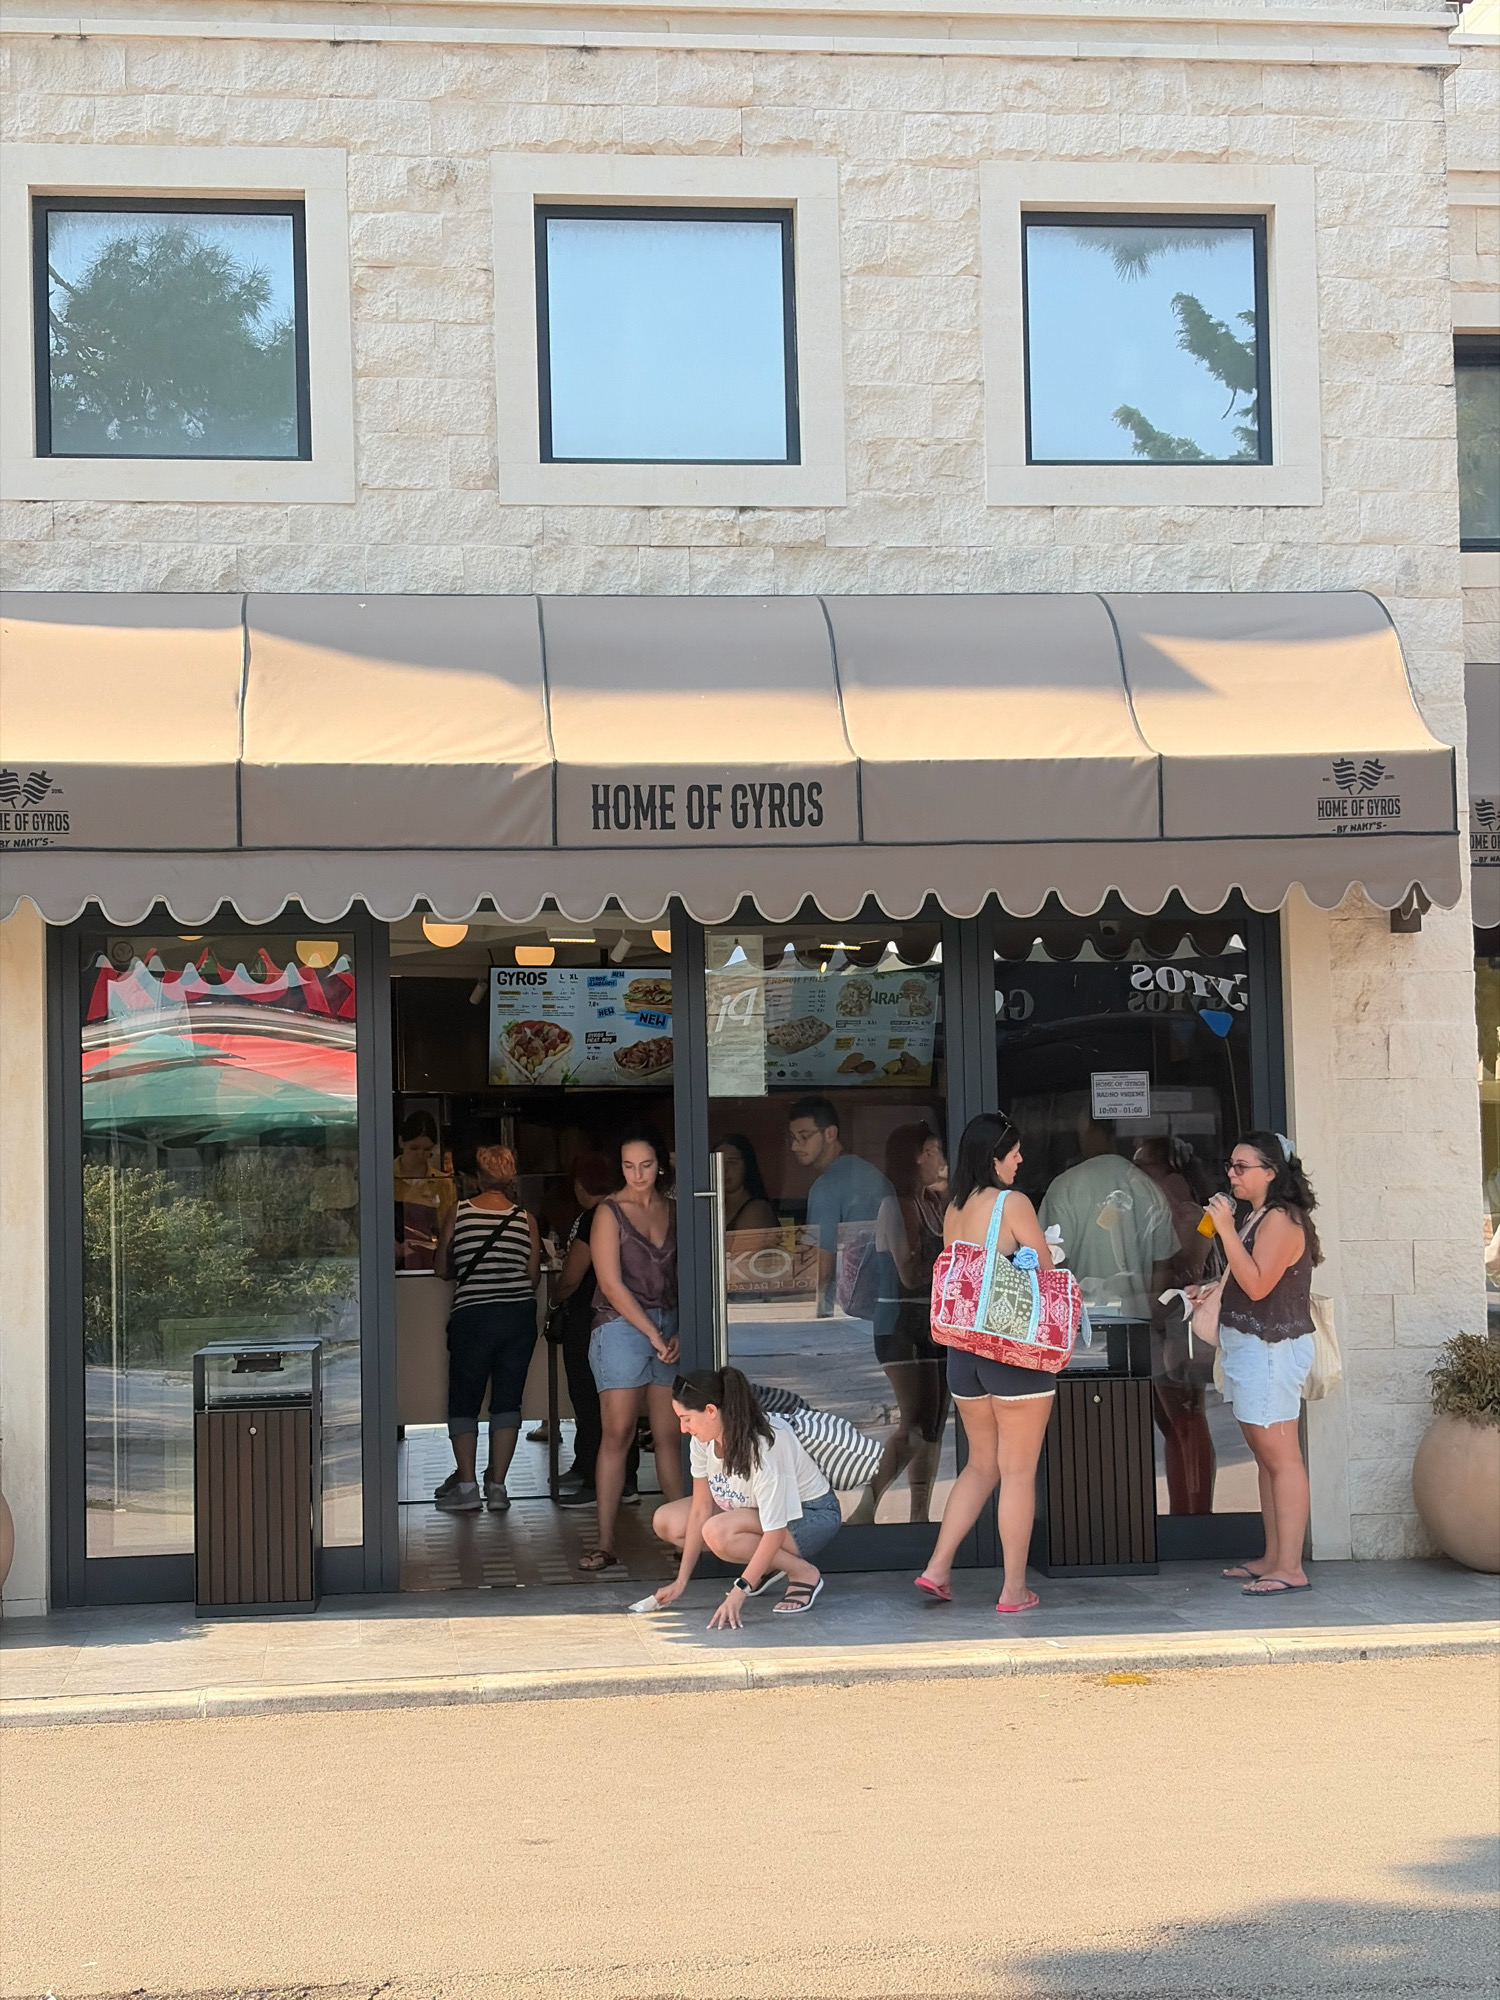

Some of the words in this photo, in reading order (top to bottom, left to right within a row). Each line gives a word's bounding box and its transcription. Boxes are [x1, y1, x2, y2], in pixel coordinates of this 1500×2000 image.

[591, 783, 676, 831] HOME
[686, 783, 723, 831] OF
[730, 781, 824, 830] GYROS
[1317, 799, 1348, 818] HOME
[1351, 799, 1365, 817] OF
[1367, 798, 1401, 816] GYROS
[14, 813, 30, 831] OF
[32, 813, 70, 831] GYROS
[1470, 834, 1489, 850] OME
[497, 971, 548, 986] GYROS
[598, 1008, 615, 1017] NEW
[639, 1012, 667, 1027] NEW
